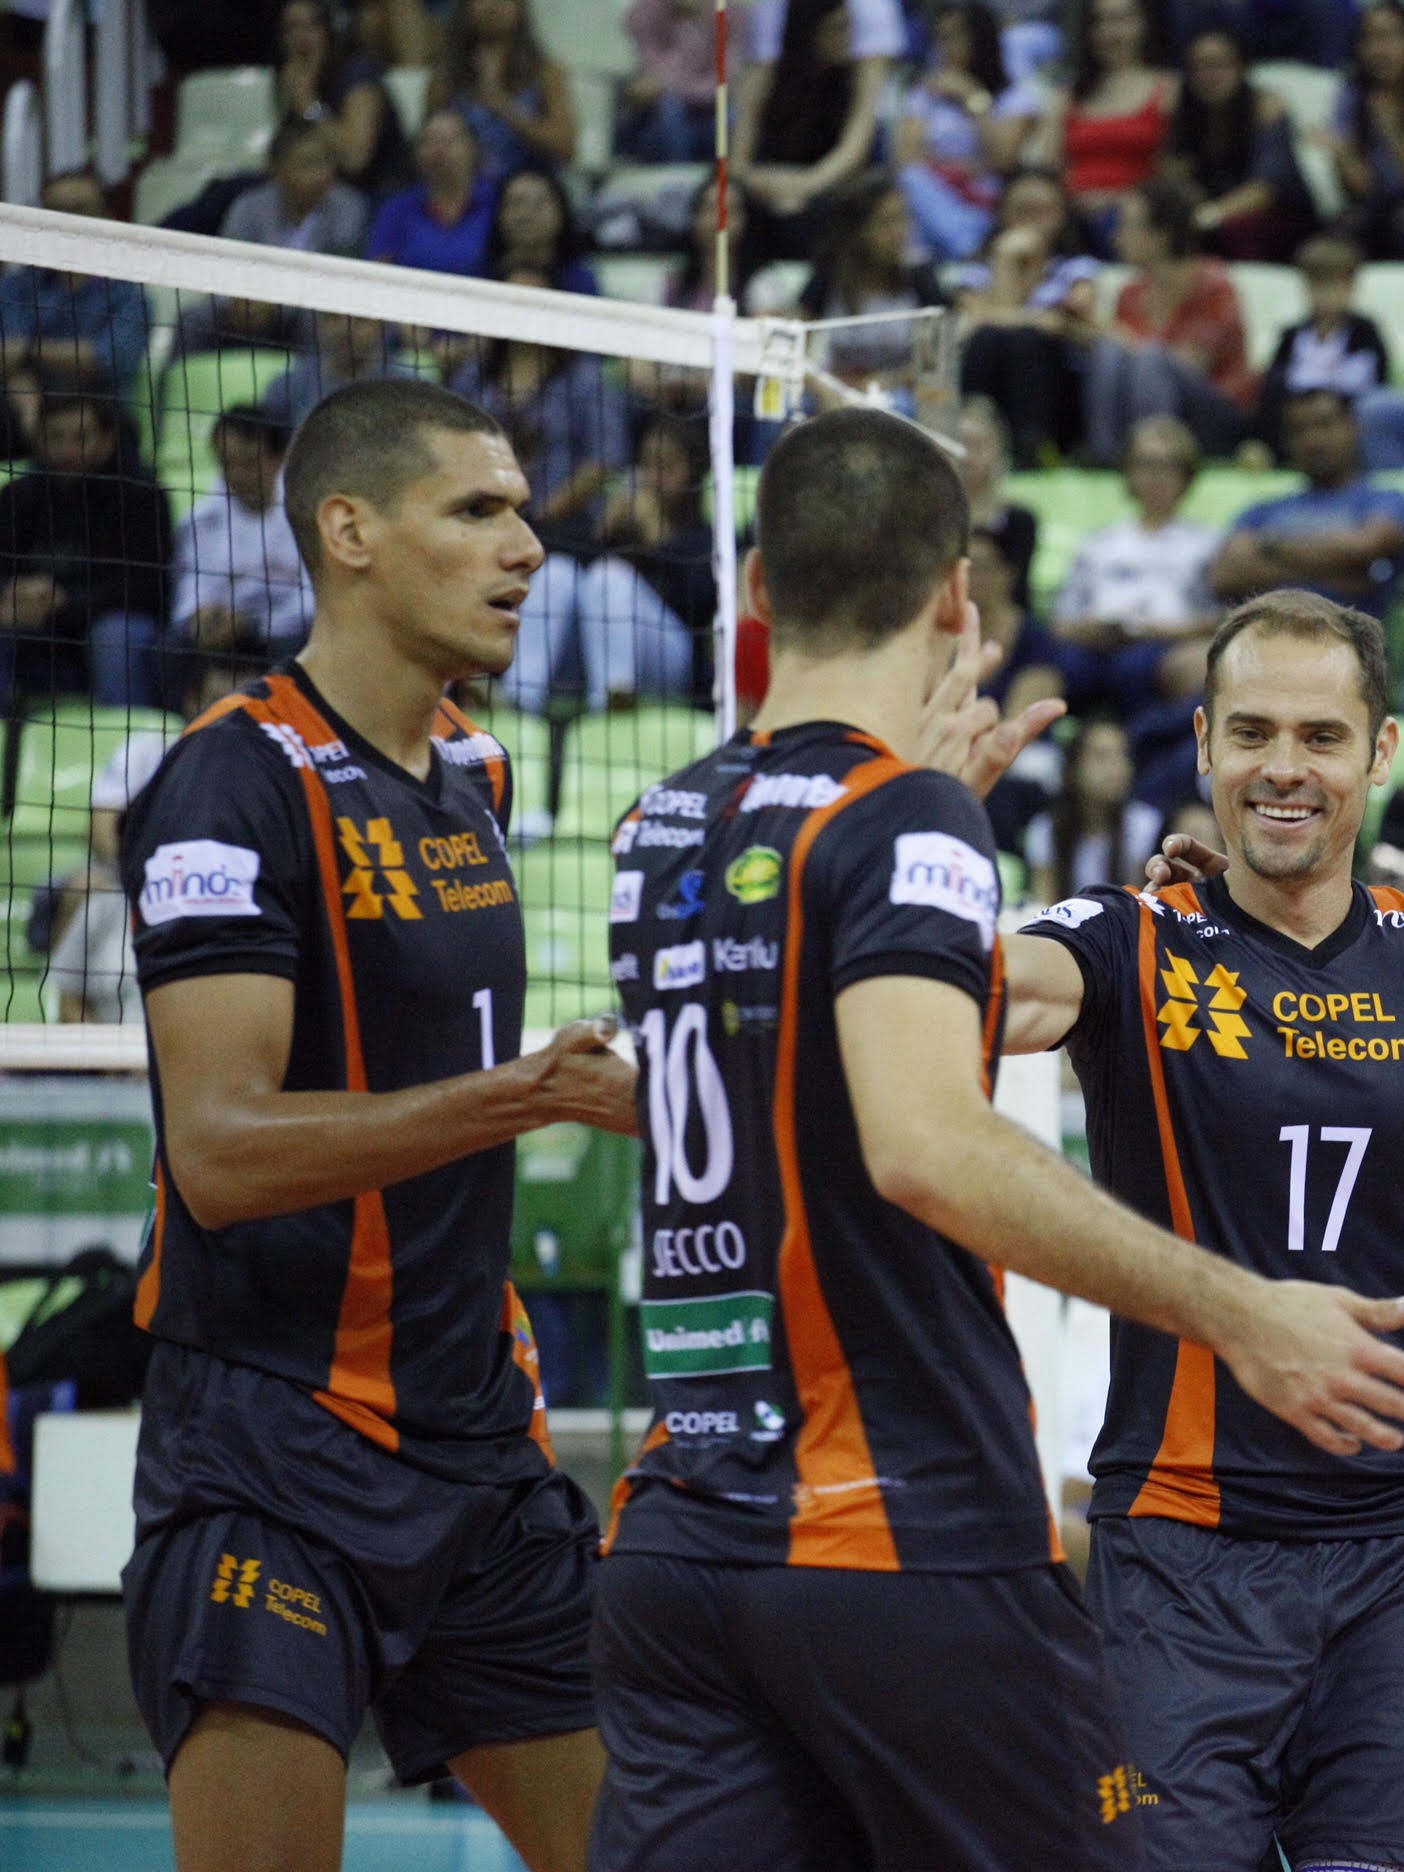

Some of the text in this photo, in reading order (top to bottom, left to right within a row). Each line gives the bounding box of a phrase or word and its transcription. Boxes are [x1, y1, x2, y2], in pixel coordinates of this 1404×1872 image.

[419, 833, 488, 870] COPEL
[431, 879, 514, 913] Telecom
[1273, 991, 1396, 1022] COPEL
[472, 988, 495, 1070] 1
[640, 1003, 733, 1205] 10
[1279, 1125, 1373, 1251] 17
[665, 1410, 740, 1434] COPEL
[268, 1579, 322, 1613] COPEL
